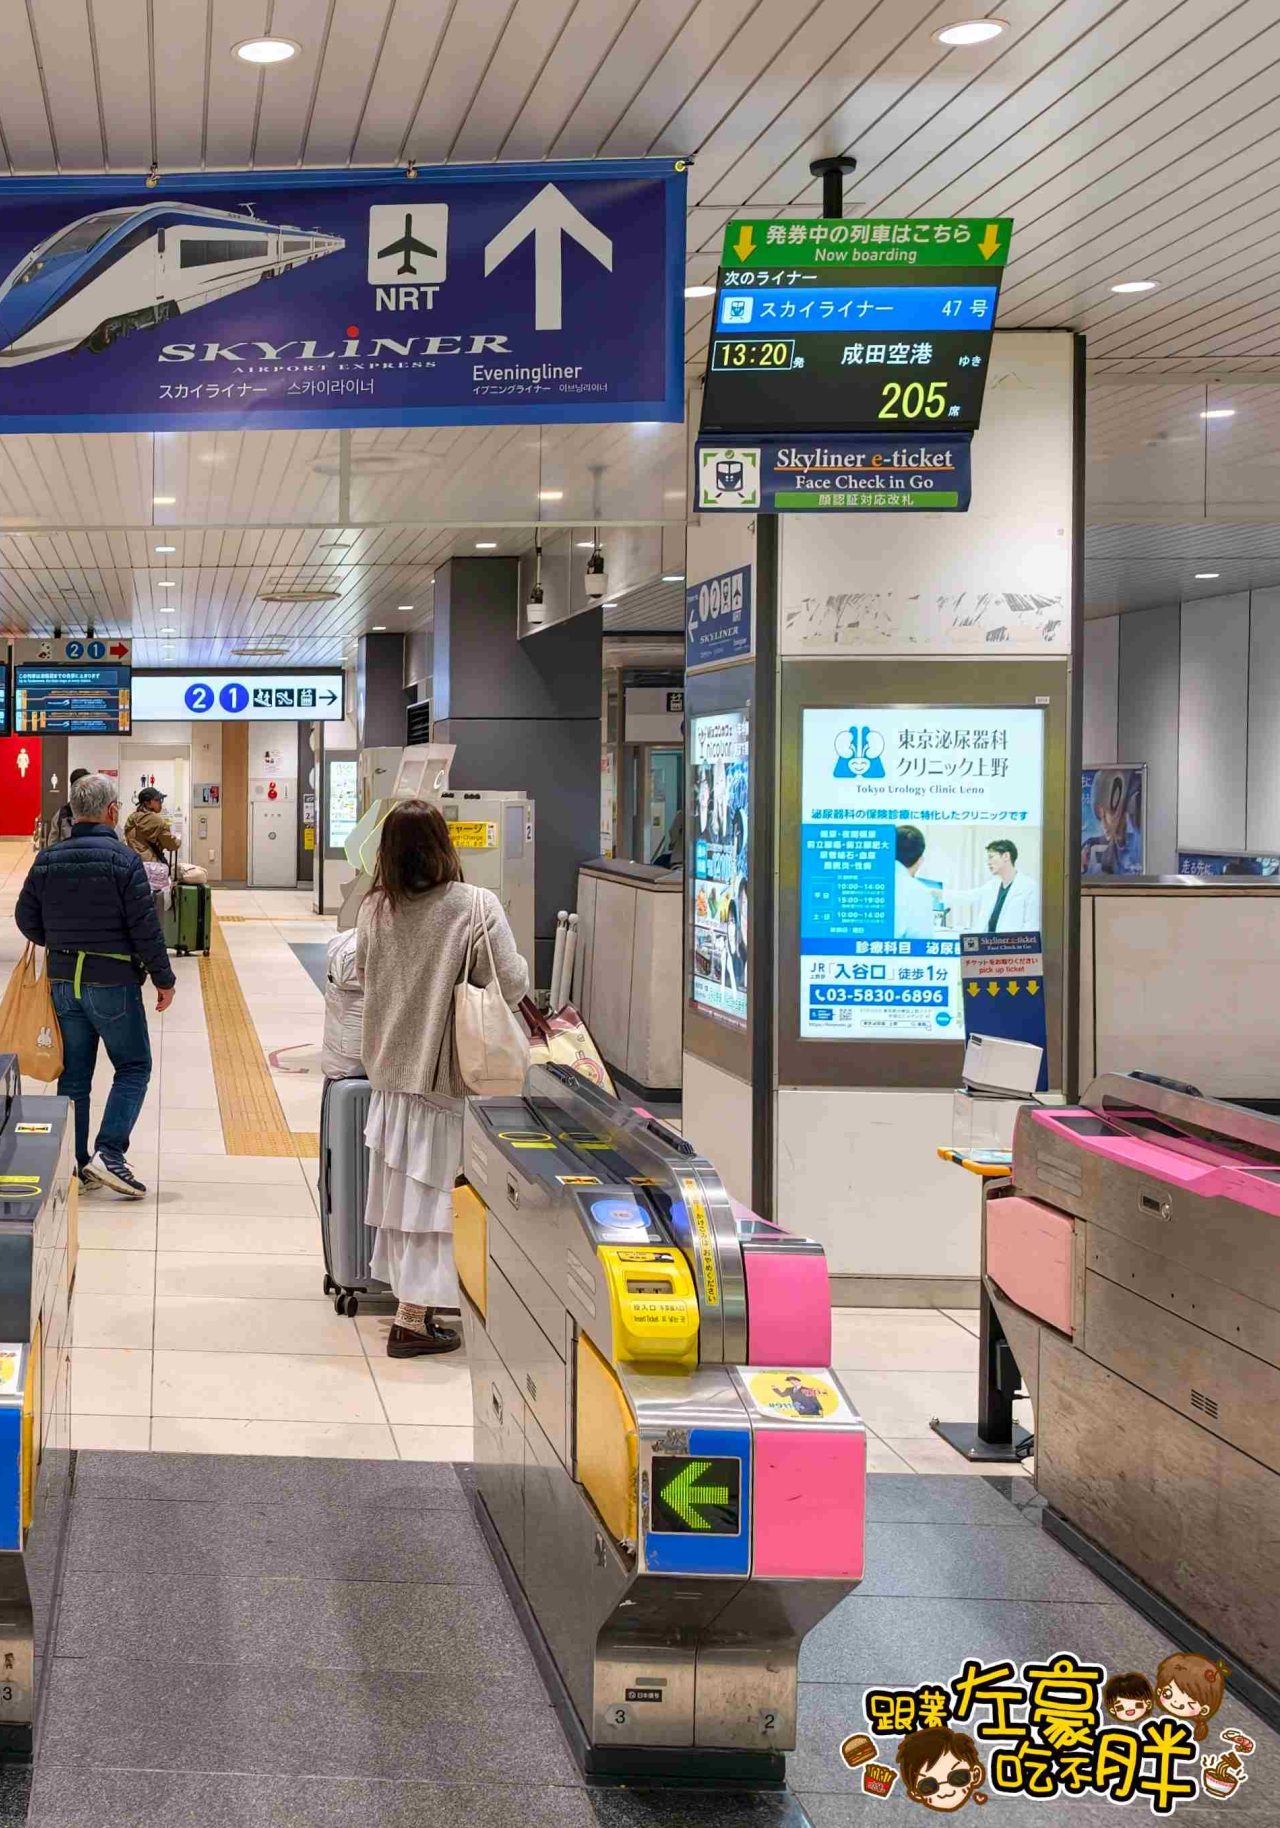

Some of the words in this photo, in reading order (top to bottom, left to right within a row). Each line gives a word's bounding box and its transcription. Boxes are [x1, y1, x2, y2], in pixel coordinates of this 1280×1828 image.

[766, 224, 970, 246] 発券中の列車はこちら
[815, 248, 847, 262] Now
[852, 248, 917, 264] boarding
[724, 270, 818, 286] 次のライナー
[375, 286, 440, 311] NRT
[760, 301, 894, 318] スカイライナー
[941, 300, 961, 317] 47
[969, 299, 988, 318] 号
[721, 342, 787, 366] 13:20
[792, 356, 805, 369] 発
[841, 342, 933, 365] 成田空港
[958, 355, 982, 367] ゆき
[232, 364, 328, 373] AIRPORT
[339, 361, 437, 370] EXPRESS
[472, 363, 584, 382] Eveningliner
[158, 383, 268, 399] スカイライナー
[287, 379, 375, 396] 스카이라이너
[878, 382, 948, 419] 205
[948, 405, 960, 417] 席
[776, 449, 866, 472] Skyliner
[871, 448, 953, 468] e-ticket
[795, 475, 832, 489] Face
[836, 475, 885, 489] Check
[890, 475, 905, 489] in
[910, 475, 934, 489] Go
[818, 493, 914, 507] 顔認証対応改札
[898, 729, 1008, 750] 東京泌尿器科
[897, 757, 1009, 778] クリニック上野
[856, 785, 885, 794] Tokyo
[888, 785, 926, 796] Urology
[930, 785, 957, 794] Clinic
[960, 785, 984, 794] Ueno
[811, 808, 1029, 821] 泌尿器科の保険診療に特化したクリニックです
[856, 941, 911, 954] 診療科目
[965, 958, 1038, 966] チケットをお取りください
[979, 967, 993, 975] pick
[810, 963, 825, 973] JR
[898, 965, 948, 981] 徒歩1分
[826, 988, 943, 1002] 03-5830-6896
[703, 1250, 716, 1303] おやめください
[2, 1687, 12, 1700] 3
[615, 1710, 625, 1724] 3
[764, 1714, 775, 1728] 2
